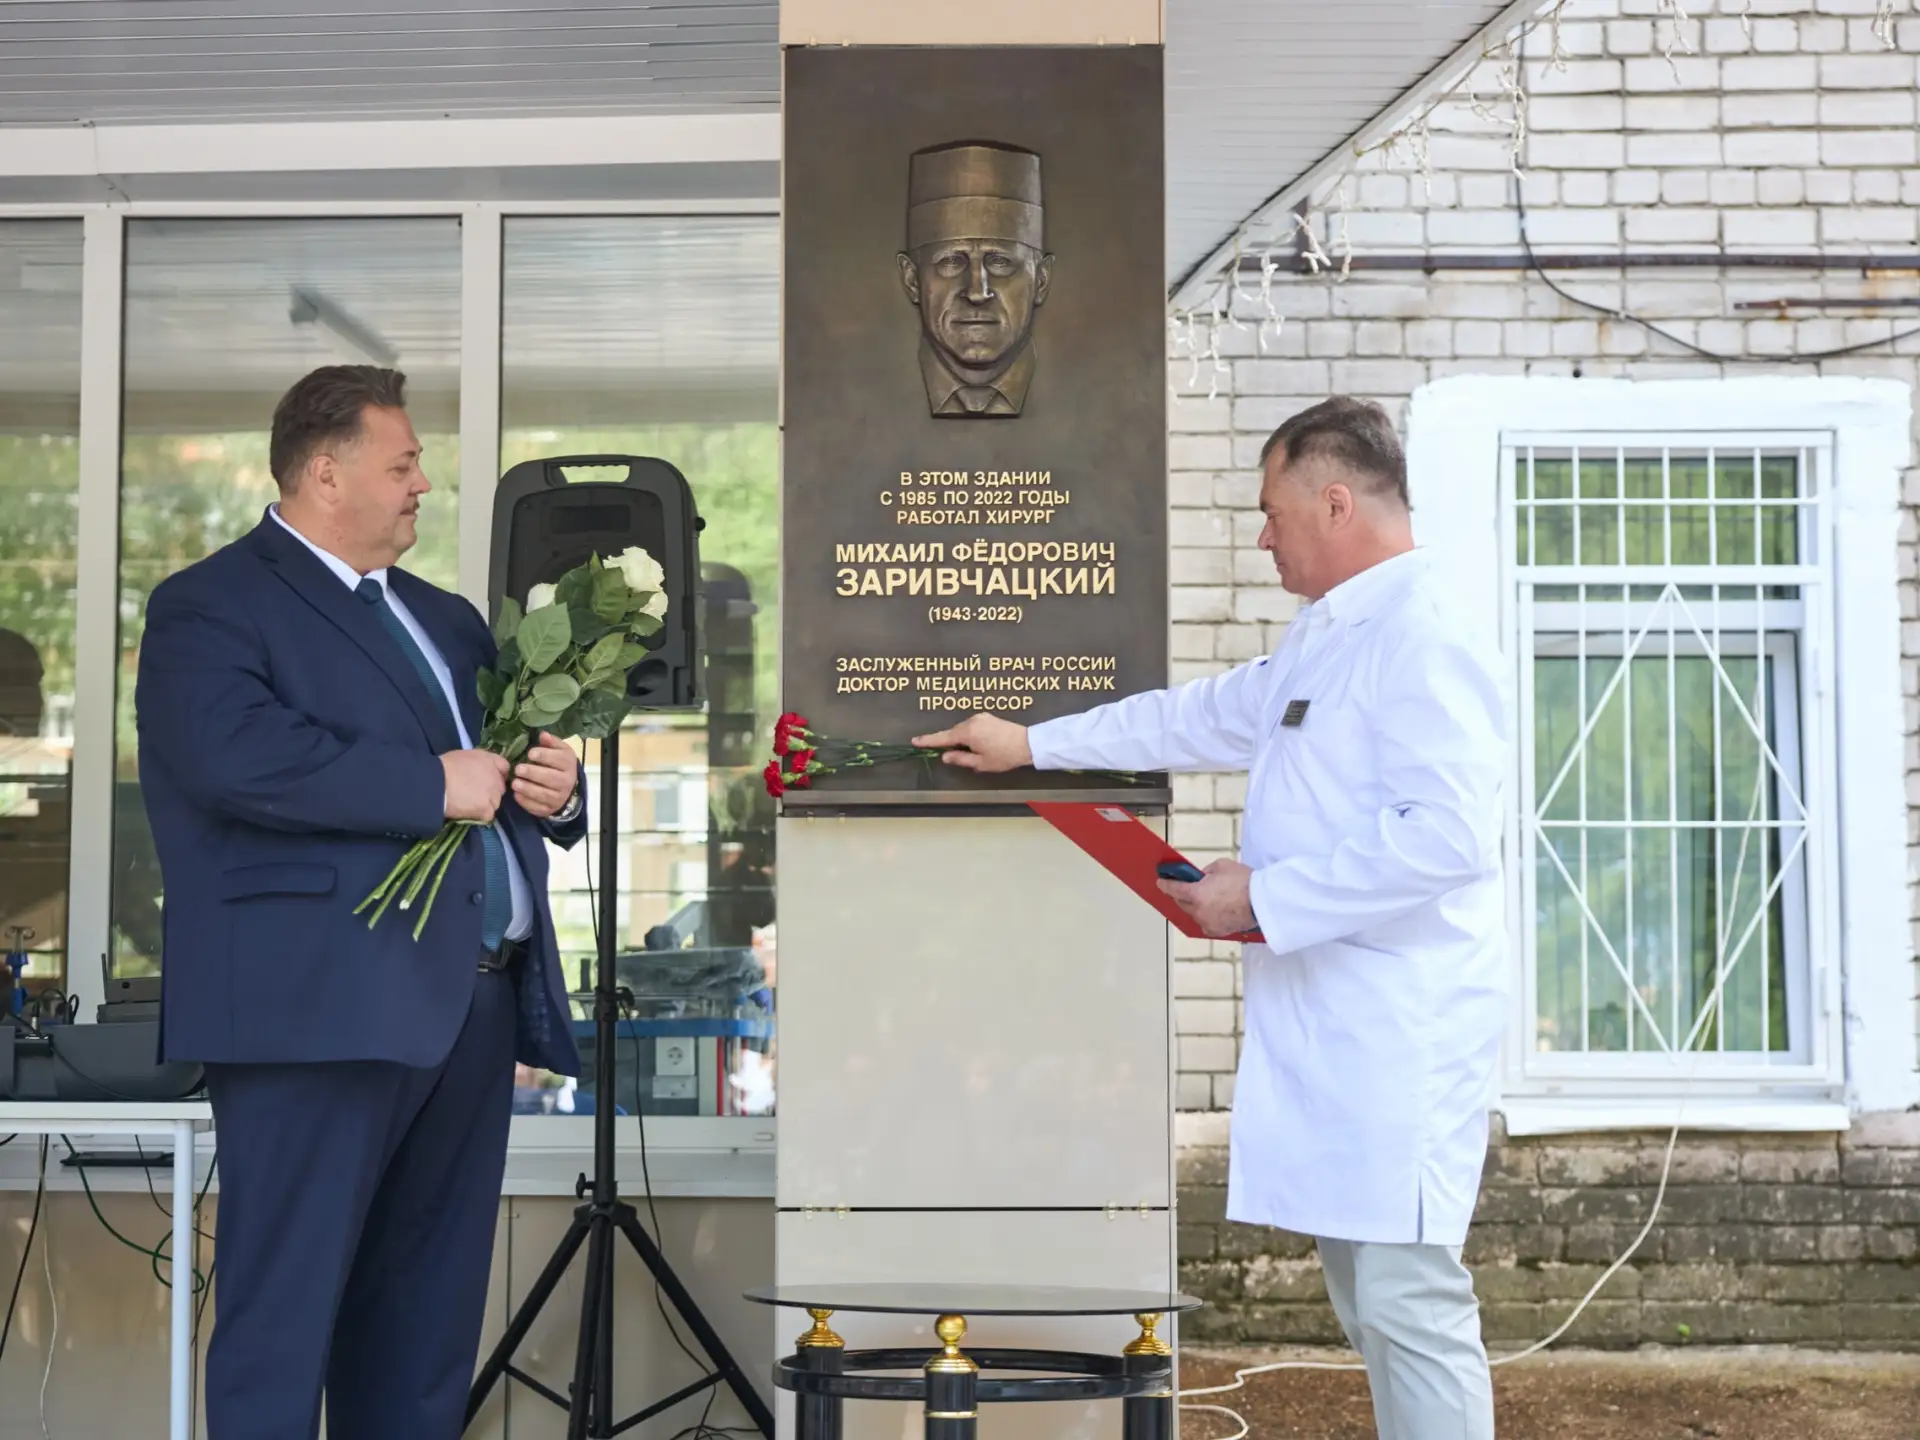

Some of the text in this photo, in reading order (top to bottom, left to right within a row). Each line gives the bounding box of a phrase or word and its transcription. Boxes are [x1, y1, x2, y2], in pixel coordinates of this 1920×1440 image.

[900, 471, 1051, 487] В ЭТОМ ЗДАНИИ
[880, 490, 1070, 507] С 1985 ПО 2022 ГОДЫ
[897, 510, 1056, 525] РАБОТАЛ ХИРУРГ
[836, 538, 1115, 566] МИХАИЛ ФЁДОРОВИЧ
[836, 562, 1116, 600] ЗАРИВЧАЦКИЙ
[928, 606, 1023, 624] (1943-2022)
[836, 654, 1116, 672] ЗАСЛУЖЕННЫЙ ВРАЧ РОССИИ
[837, 676, 1115, 693] ДОКТОР МЕДИЦИНСКИХ НАУК
[919, 695, 1034, 711] ПРОФЕССОР
